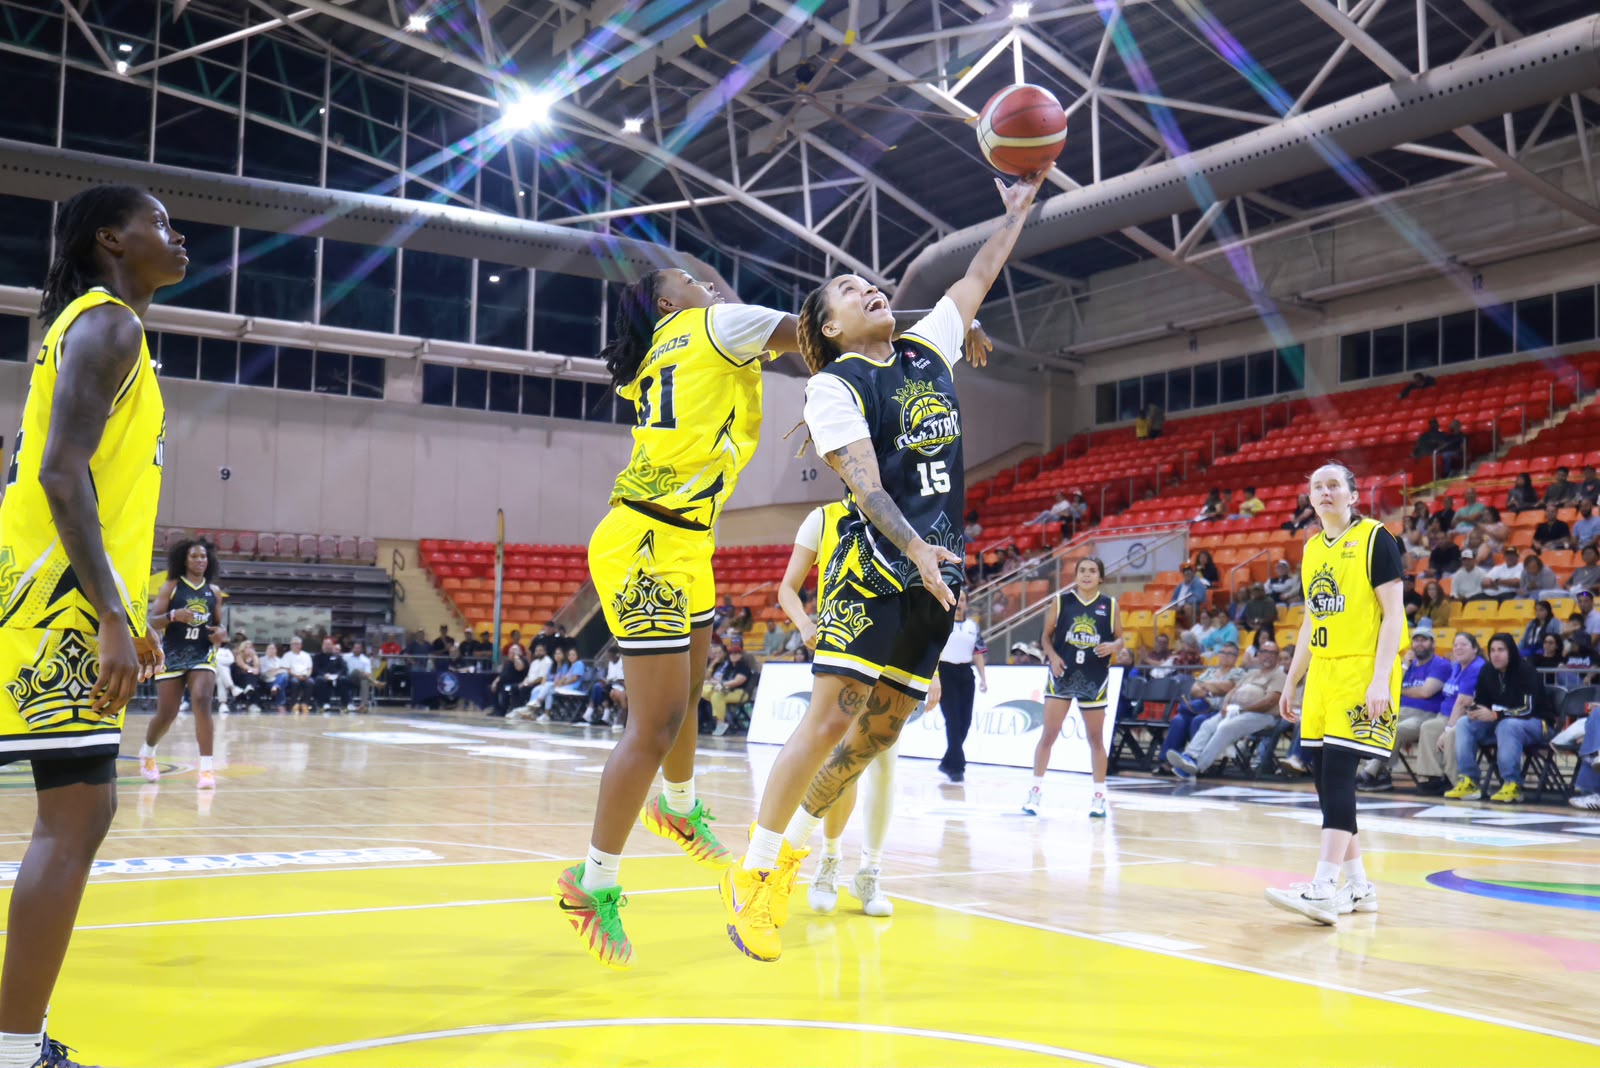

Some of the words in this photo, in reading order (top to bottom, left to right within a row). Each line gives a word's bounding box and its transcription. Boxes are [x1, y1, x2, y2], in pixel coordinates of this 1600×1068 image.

[220, 468, 231, 480] 9
[801, 468, 817, 481] 10
[916, 460, 951, 496] 15
[184, 628, 200, 640] 10
[1075, 650, 1086, 665] 8
[975, 712, 1017, 736] VILLA
